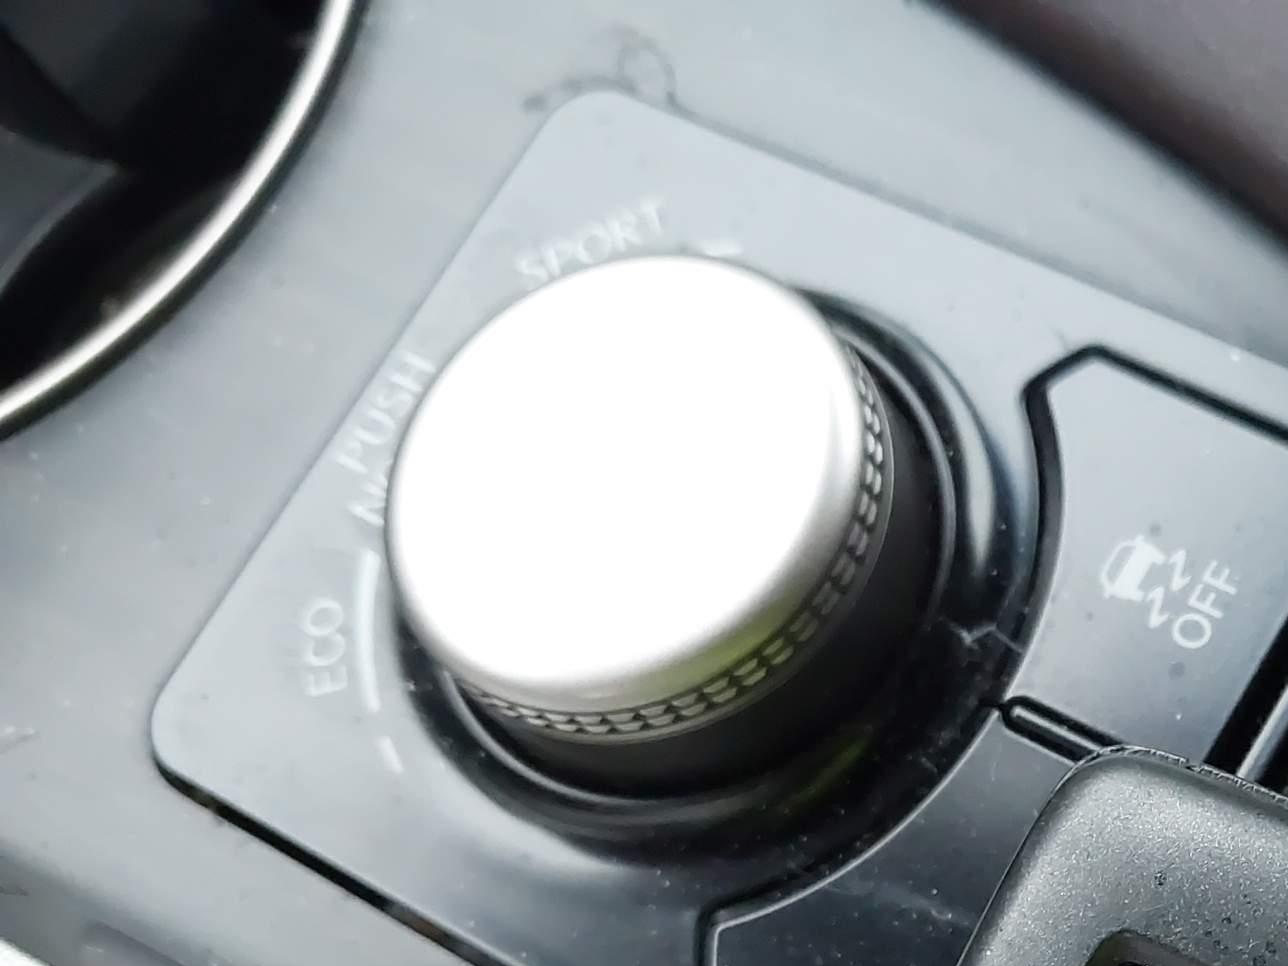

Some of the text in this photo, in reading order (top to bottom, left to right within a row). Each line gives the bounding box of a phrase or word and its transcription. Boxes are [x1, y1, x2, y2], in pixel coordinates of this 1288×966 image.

[514, 198, 667, 279] SPORT
[335, 350, 436, 475] PUSH
[300, 599, 347, 697] ECO
[1172, 560, 1239, 649] OFF
